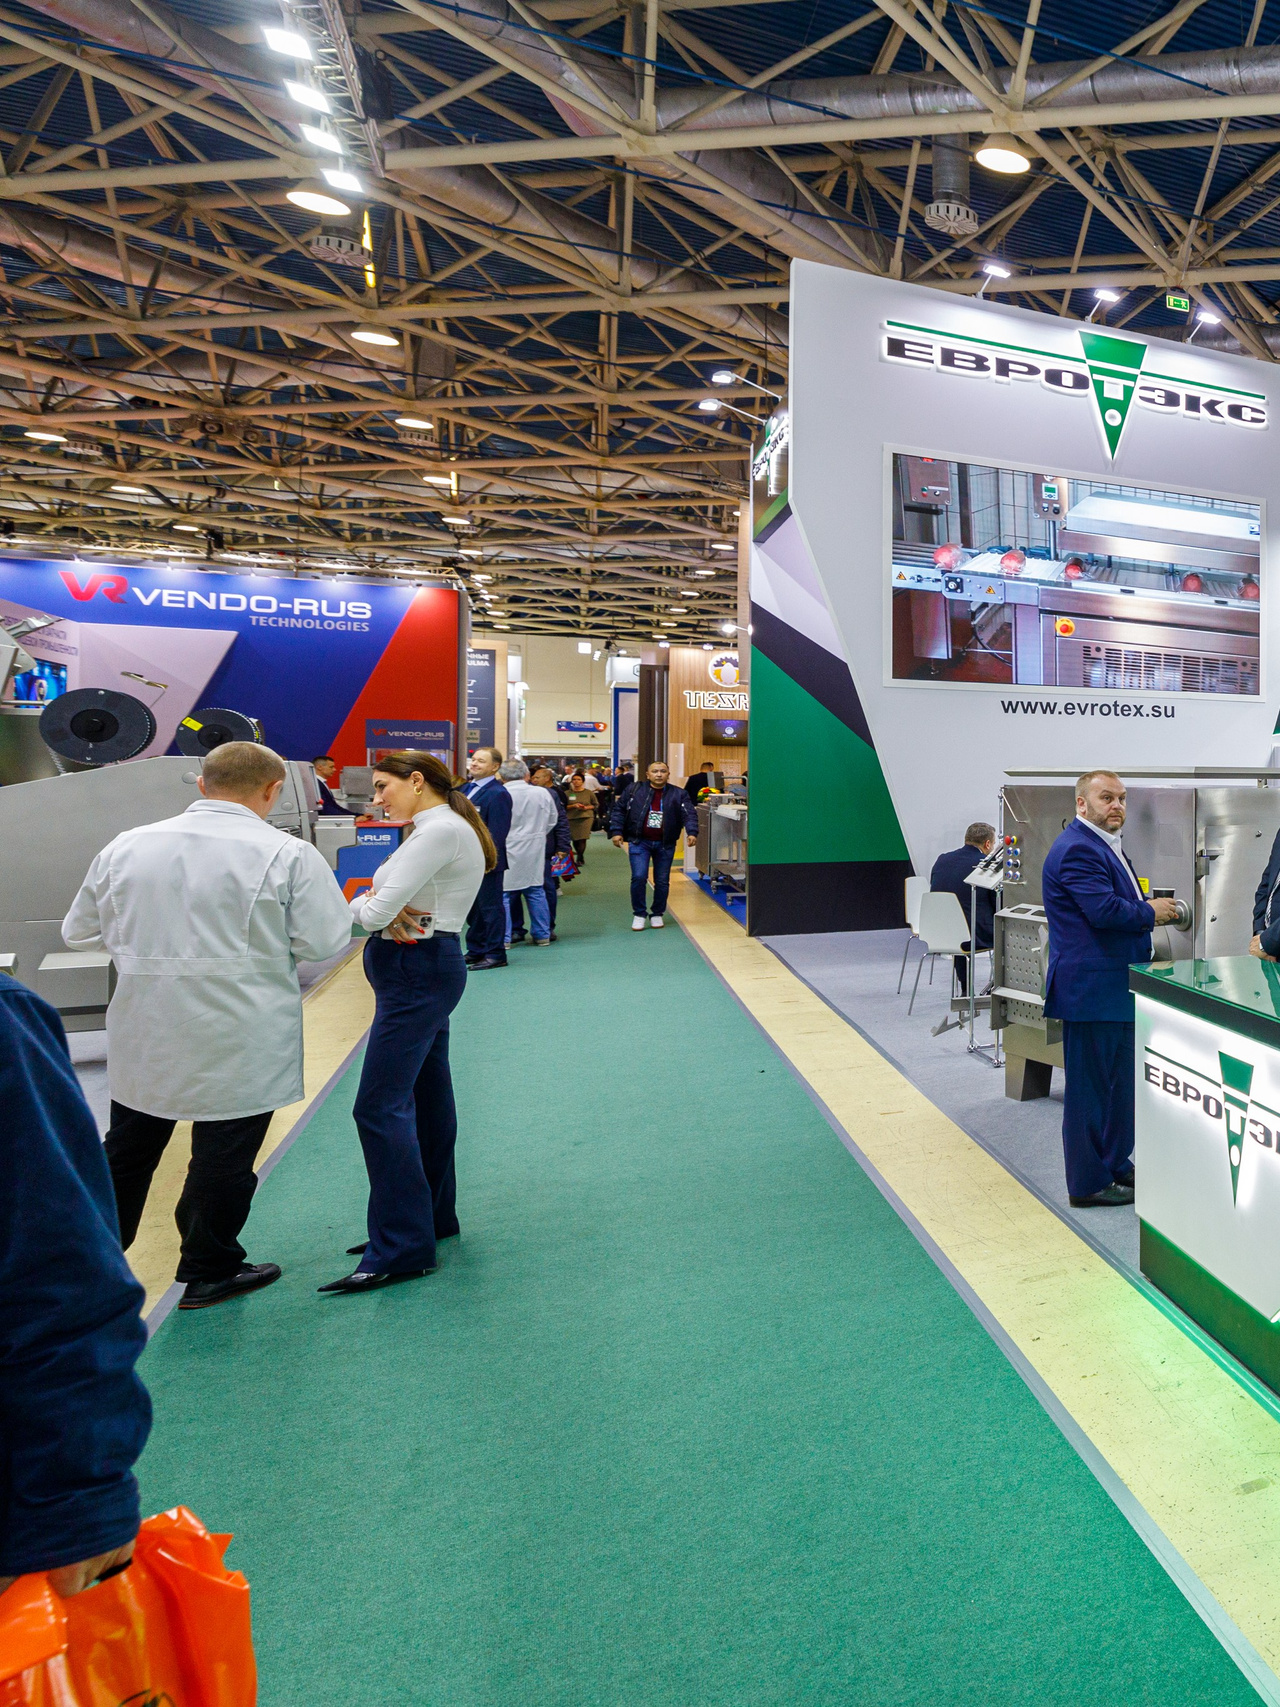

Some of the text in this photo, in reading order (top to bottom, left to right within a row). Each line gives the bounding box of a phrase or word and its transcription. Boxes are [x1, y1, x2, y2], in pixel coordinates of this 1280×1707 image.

[885, 336, 1267, 424] ЕВРОТЭКС
[58, 570, 372, 619] VR VENDO-RUS
[249, 615, 370, 632] TECHNOLOGIES
[1001, 700, 1175, 718] www.evrotex.su
[356, 834, 392, 842] -RUS
